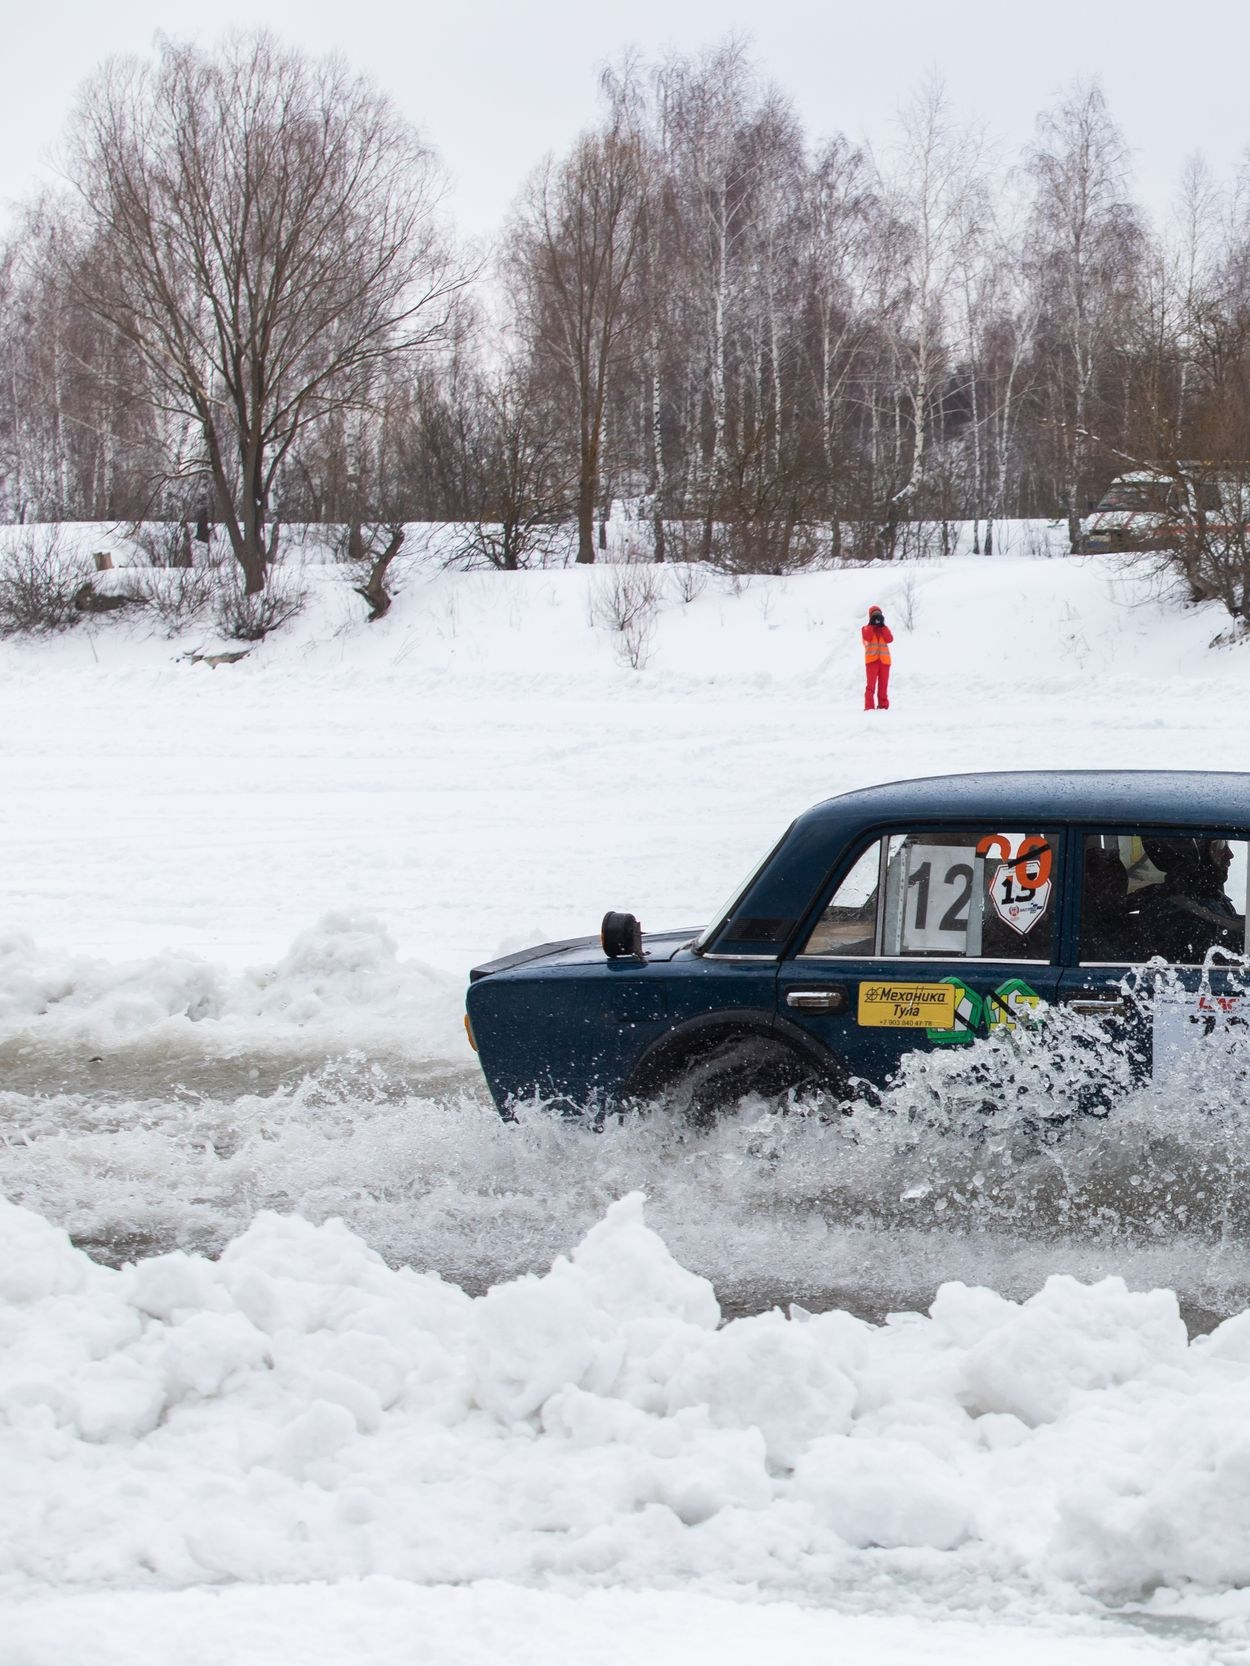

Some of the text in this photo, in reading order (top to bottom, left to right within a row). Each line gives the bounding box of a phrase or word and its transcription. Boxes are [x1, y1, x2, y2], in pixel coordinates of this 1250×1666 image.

[906, 861, 974, 932] 12
[880, 987, 945, 1003] Механика
[893, 1004, 920, 1019] Тула
